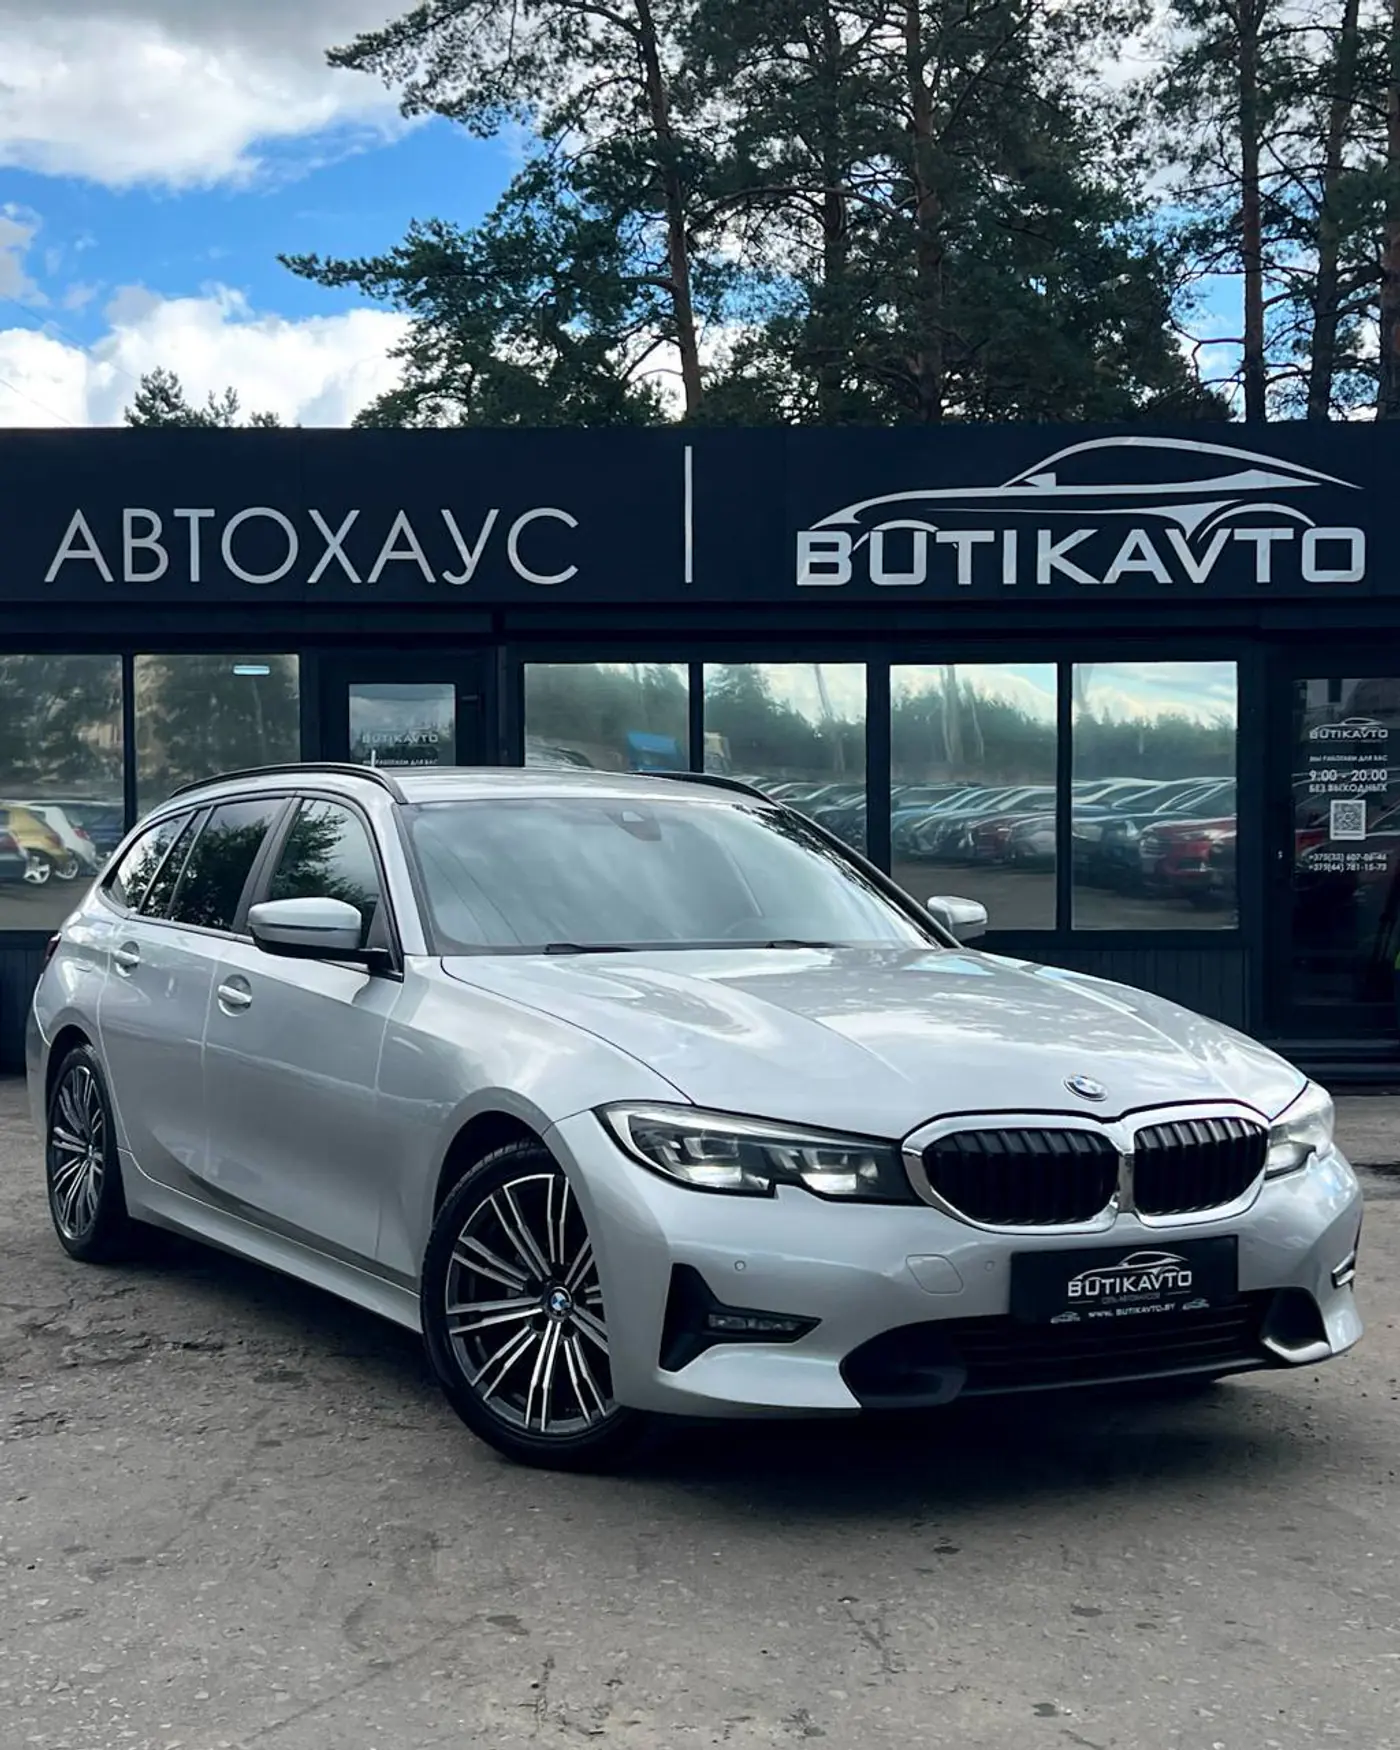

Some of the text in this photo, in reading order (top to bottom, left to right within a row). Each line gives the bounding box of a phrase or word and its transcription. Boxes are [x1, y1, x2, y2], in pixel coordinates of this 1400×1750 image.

[44, 507, 579, 585] АВТОХАУС
[796, 526, 1367, 586] BUTIKAVTO
[1309, 728, 1389, 740] BUTIKAVTO
[1327, 783, 1388, 793] ВЫХОДНЫХ
[1067, 1270, 1192, 1297] BUTIKAVTO
